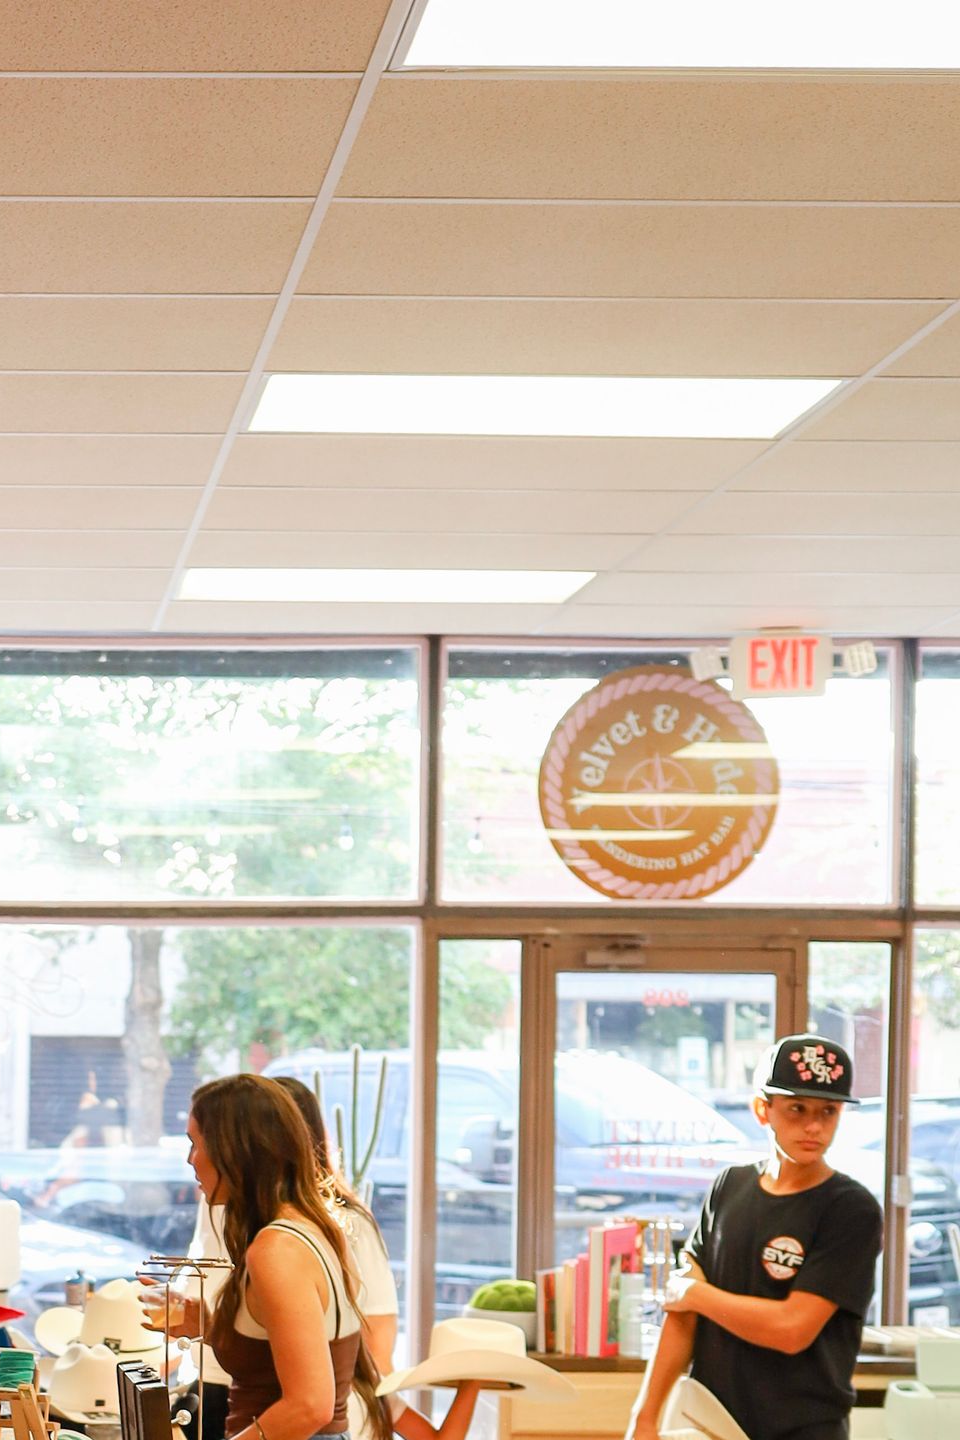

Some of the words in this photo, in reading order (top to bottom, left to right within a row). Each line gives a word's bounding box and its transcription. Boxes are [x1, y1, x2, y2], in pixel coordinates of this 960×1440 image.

[748, 638, 819, 690] EXIT
[651, 703, 680, 734] &
[681, 713, 743, 801] Hde
[680, 841, 711, 866] HAT
[709, 814, 736, 848] BAR
[761, 1246, 805, 1267] SYF
